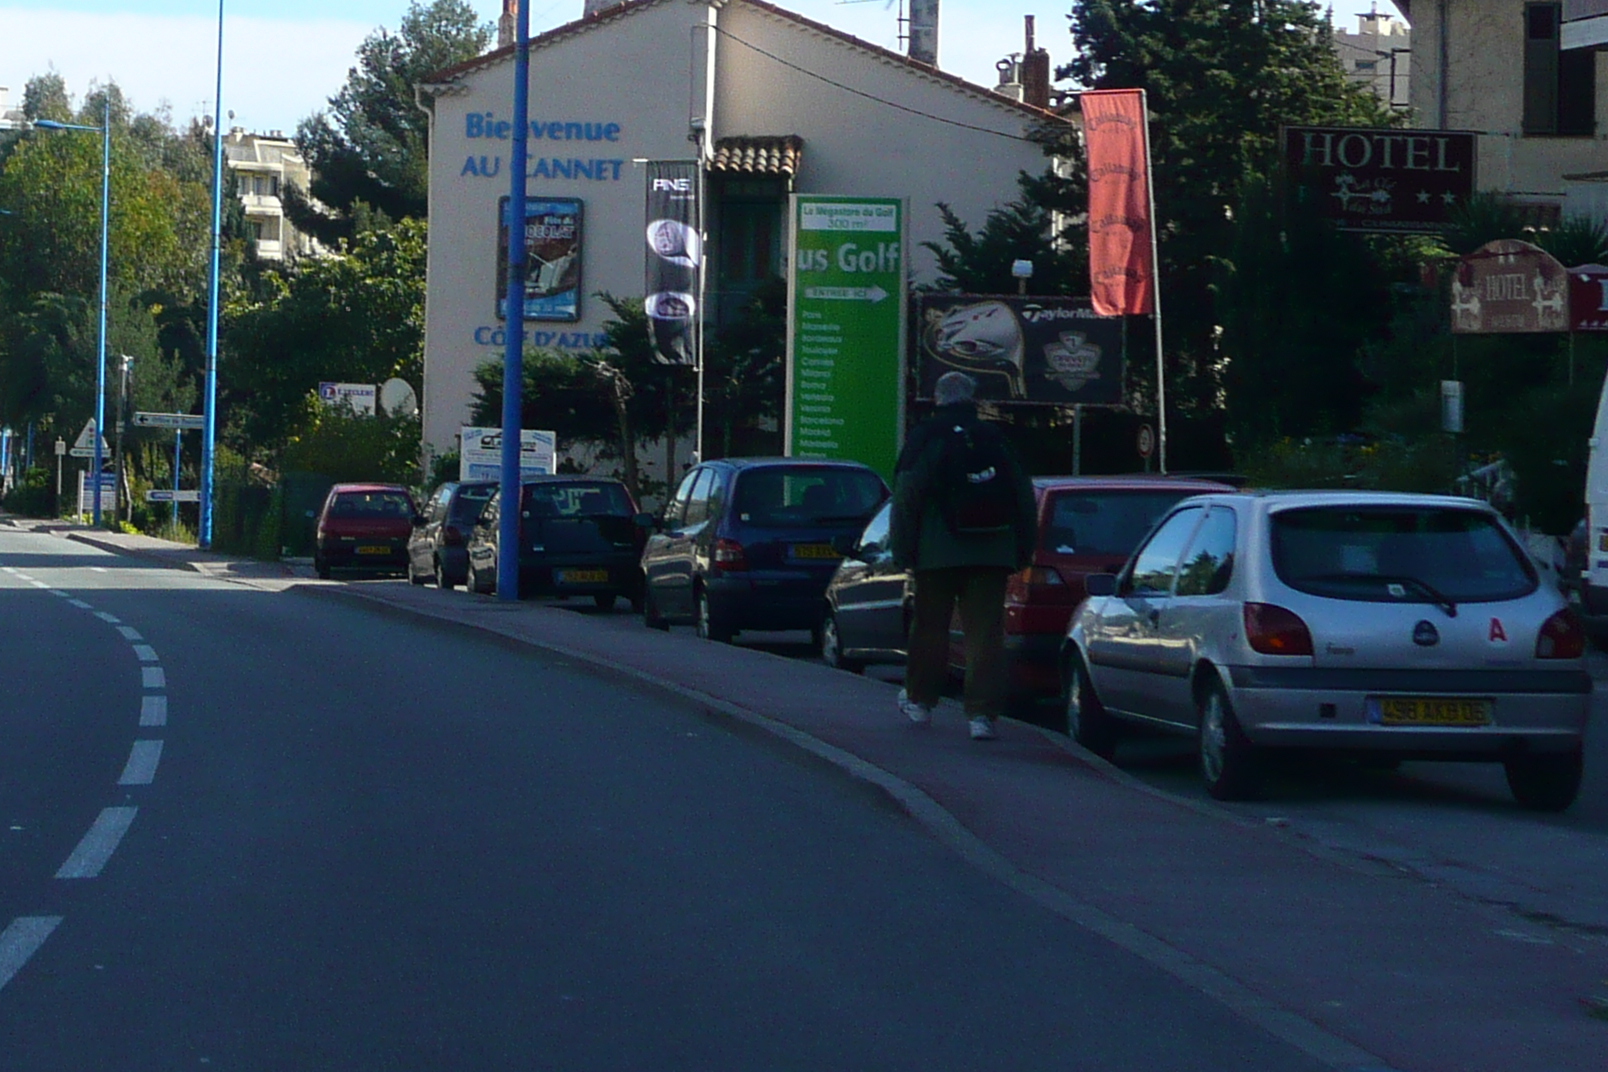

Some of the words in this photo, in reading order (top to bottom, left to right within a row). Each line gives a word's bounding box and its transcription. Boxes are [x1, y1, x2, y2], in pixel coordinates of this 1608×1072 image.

[465, 112, 621, 142] Bievenue
[1301, 131, 1461, 172] HOTEL
[460, 155, 500, 177] AU
[524, 225, 575, 239] OCOLAT
[838, 242, 901, 273] Golf
[1486, 273, 1531, 301] HOTEL
[473, 325, 529, 346] CÔ
[534, 330, 609, 348] D'AZU
[1489, 617, 1508, 642] A
